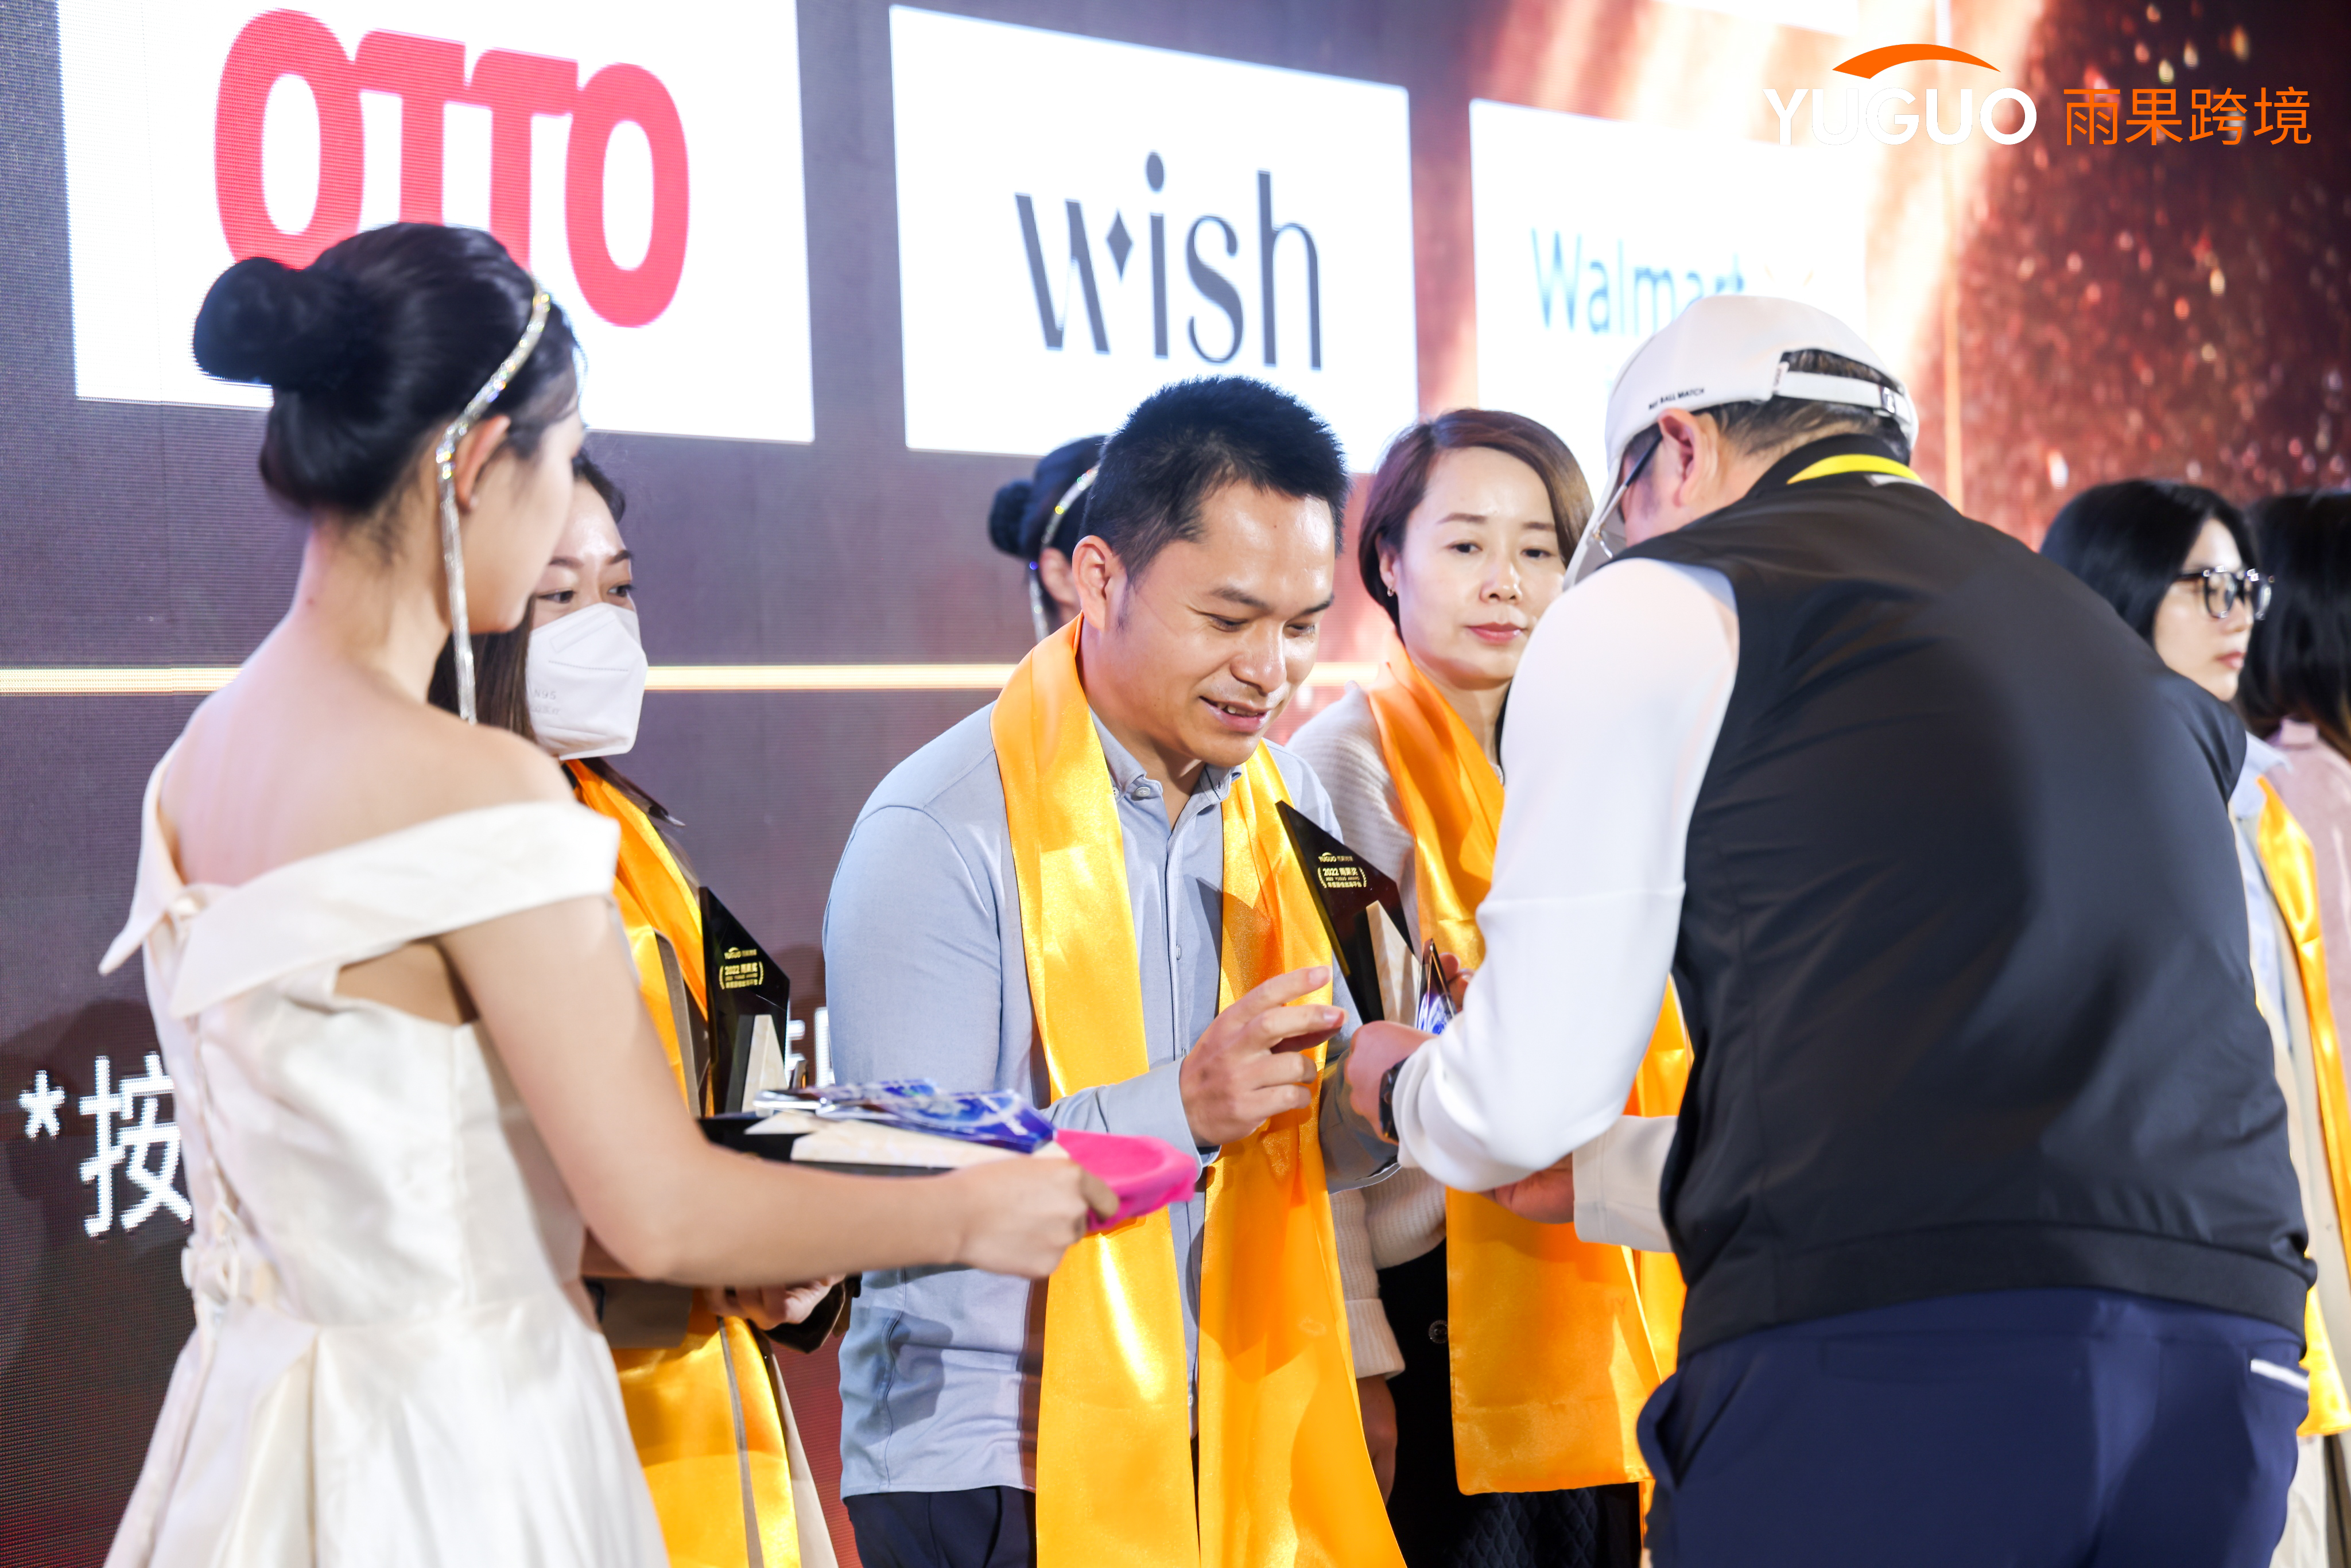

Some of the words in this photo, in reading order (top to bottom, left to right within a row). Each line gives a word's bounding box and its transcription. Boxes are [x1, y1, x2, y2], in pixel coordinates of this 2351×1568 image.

[214, 7, 690, 328] OTTO
[1014, 150, 1322, 371] wish
[1322, 867, 1339, 877] 2022
